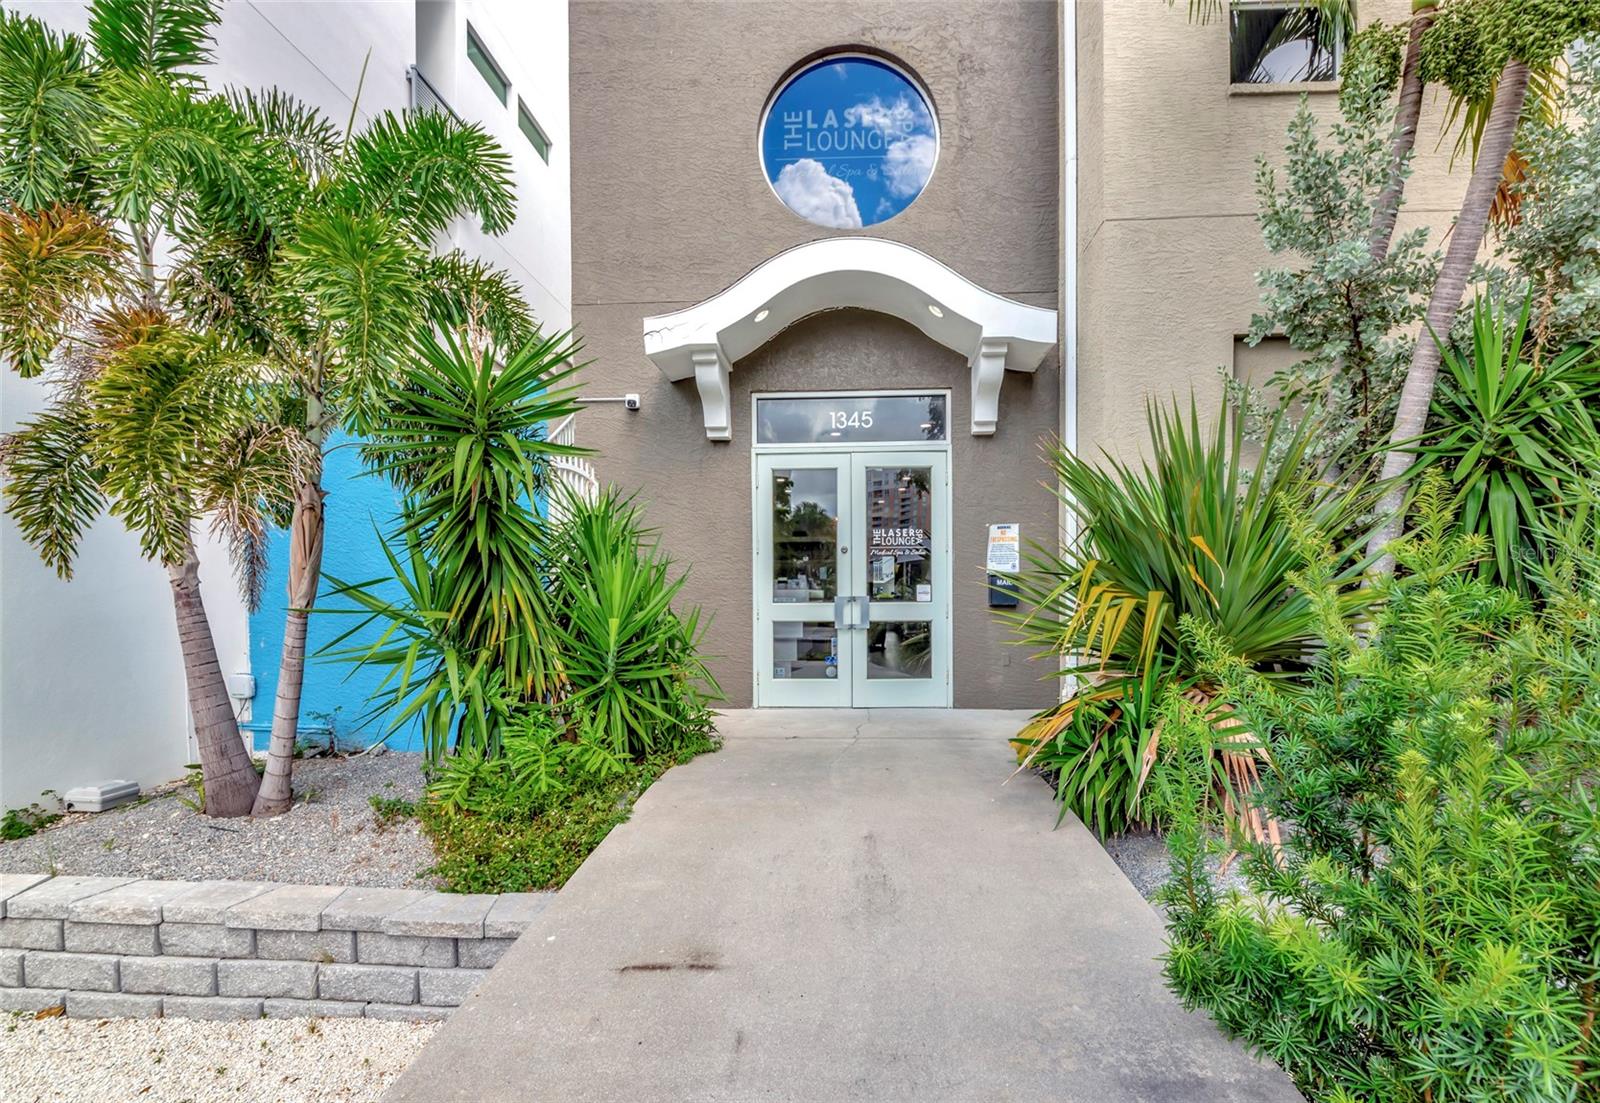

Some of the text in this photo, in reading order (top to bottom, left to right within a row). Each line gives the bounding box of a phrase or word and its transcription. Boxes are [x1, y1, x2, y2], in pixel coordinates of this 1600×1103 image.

[783, 111, 803, 151] THE
[806, 129, 895, 152] LOUNGE
[829, 411, 873, 429] 1345
[873, 529, 881, 545] THE
[882, 528, 915, 537] LASER
[881, 537, 916, 546] LOUNGE
